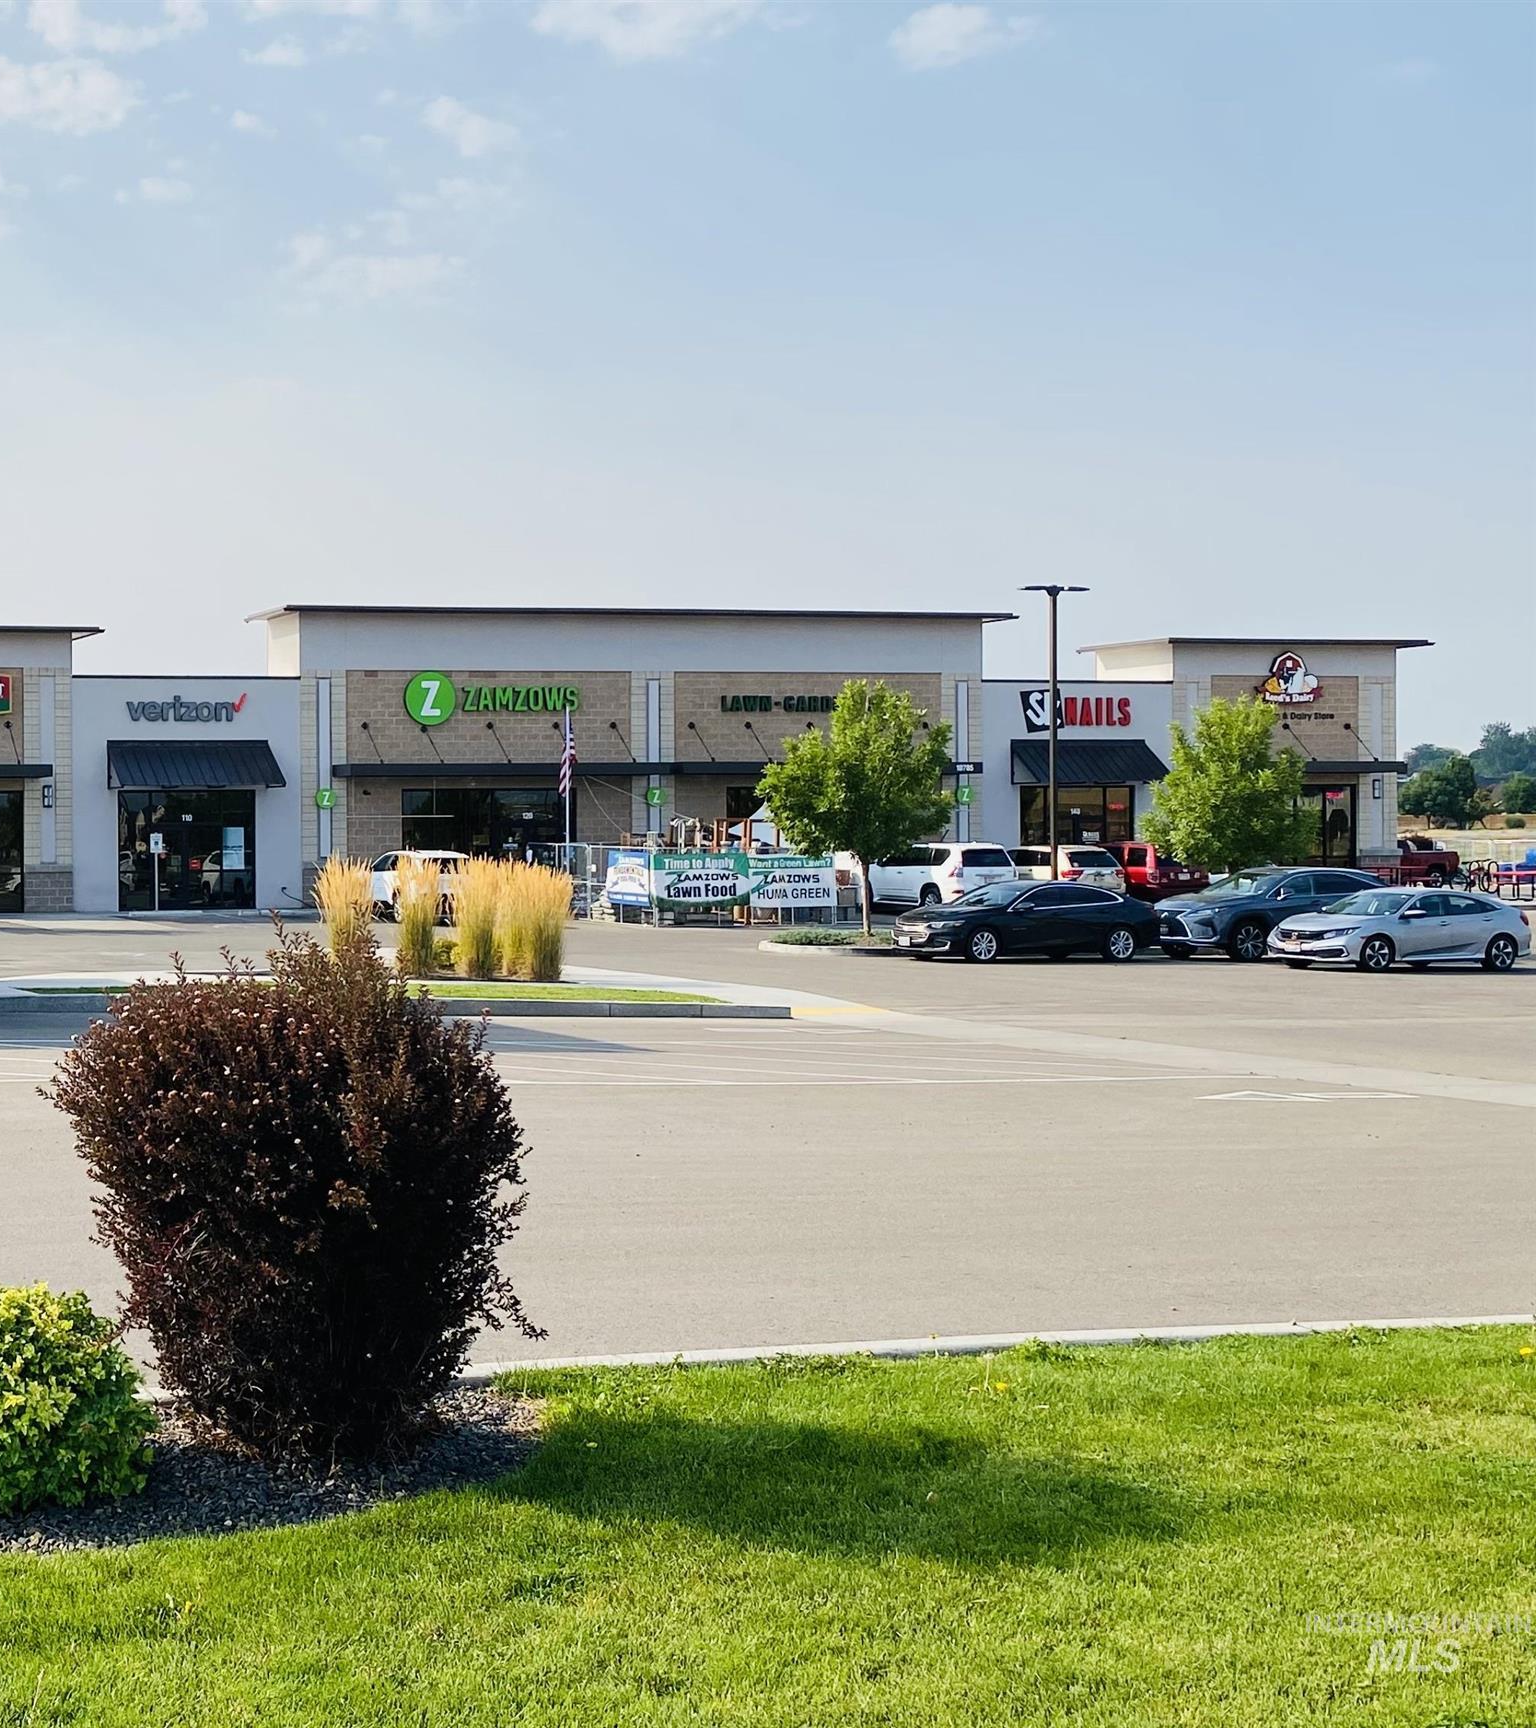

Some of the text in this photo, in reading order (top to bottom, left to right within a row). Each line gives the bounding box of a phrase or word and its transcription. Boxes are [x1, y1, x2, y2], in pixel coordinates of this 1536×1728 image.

[420, 681, 580, 717] Z ZAMZOWS
[125, 695, 234, 722] verizon
[1064, 697, 1132, 727] NAILS
[1290, 711, 1312, 722] Dairy
[1314, 712, 1335, 720] Store
[664, 857, 734, 869] Time to Apply
[676, 872, 739, 882] ZAMZOWS
[763, 874, 820, 884] ZAMZOWS
[666, 883, 737, 898] Lawn Food
[791, 887, 831, 899] GREEN
